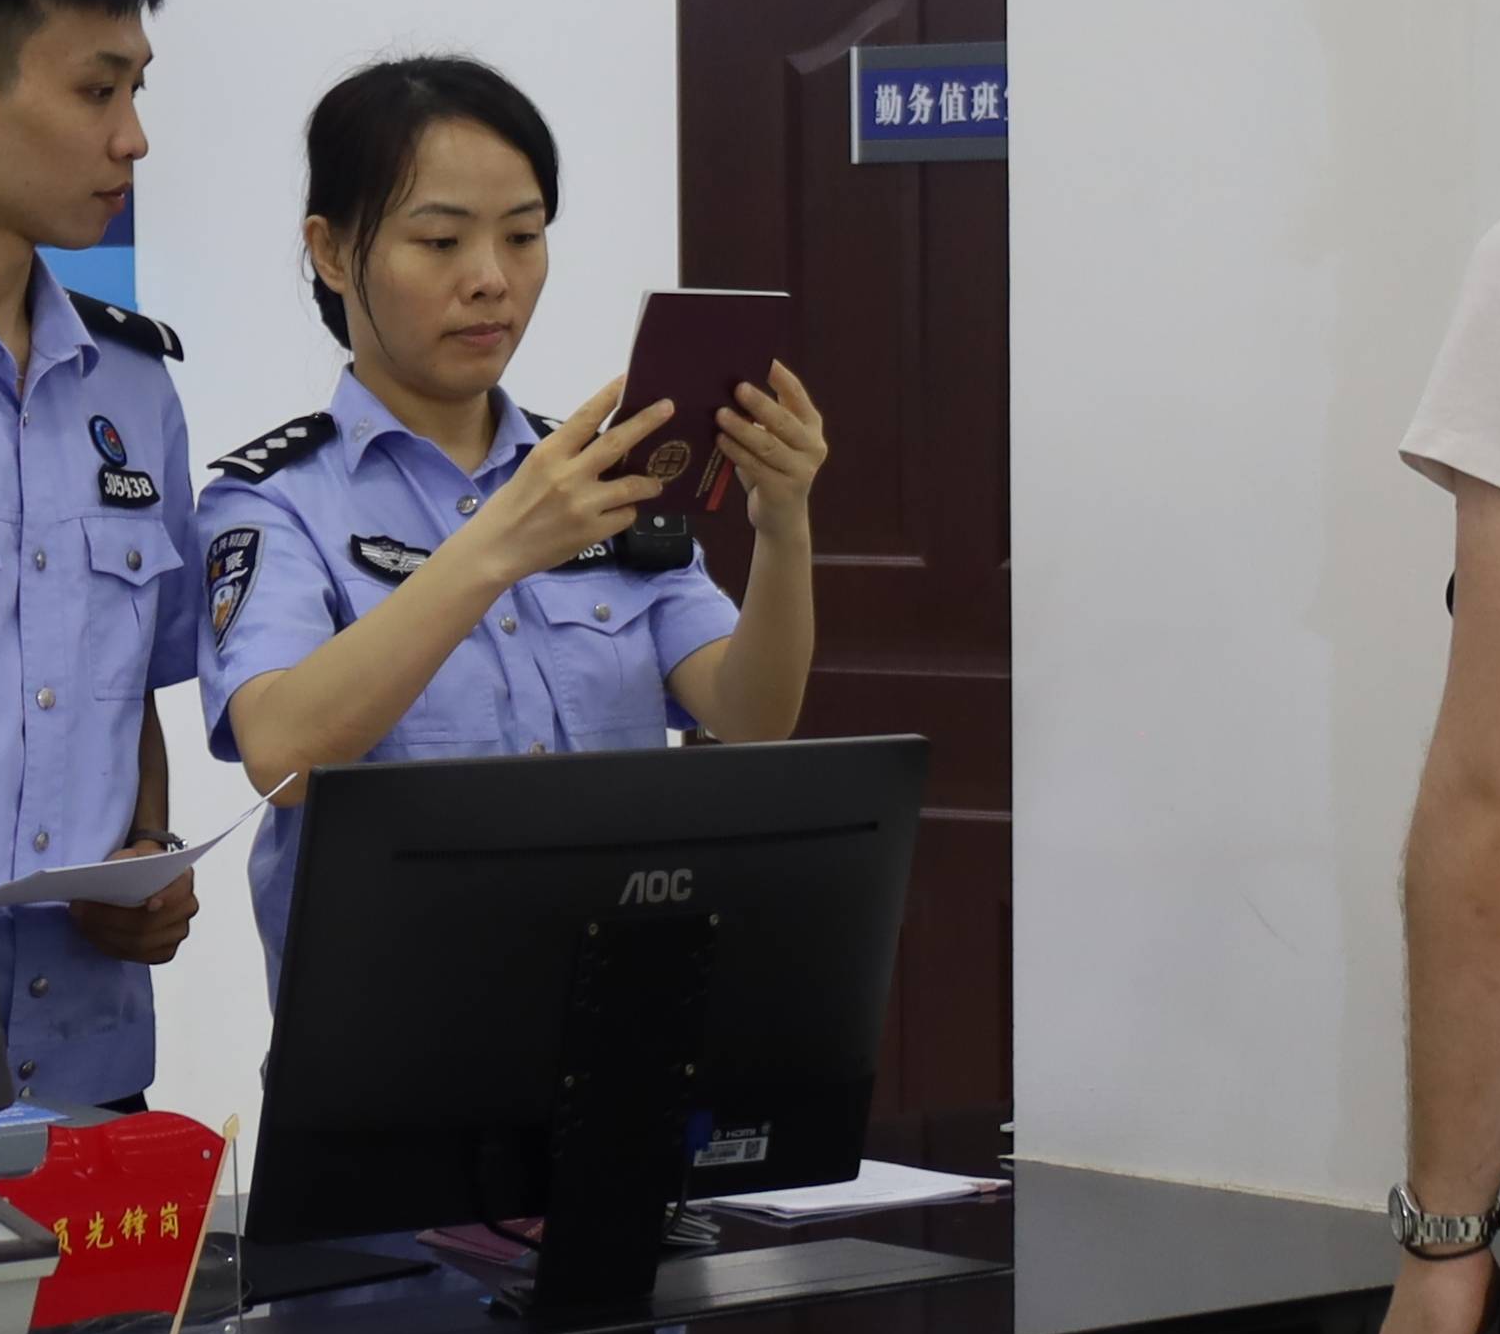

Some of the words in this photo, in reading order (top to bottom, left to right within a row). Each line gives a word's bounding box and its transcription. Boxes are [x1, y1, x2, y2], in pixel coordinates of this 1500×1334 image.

[874, 81, 1009, 126] 勤务值班
[103, 472, 153, 499] 305438
[618, 868, 693, 905] AOC
